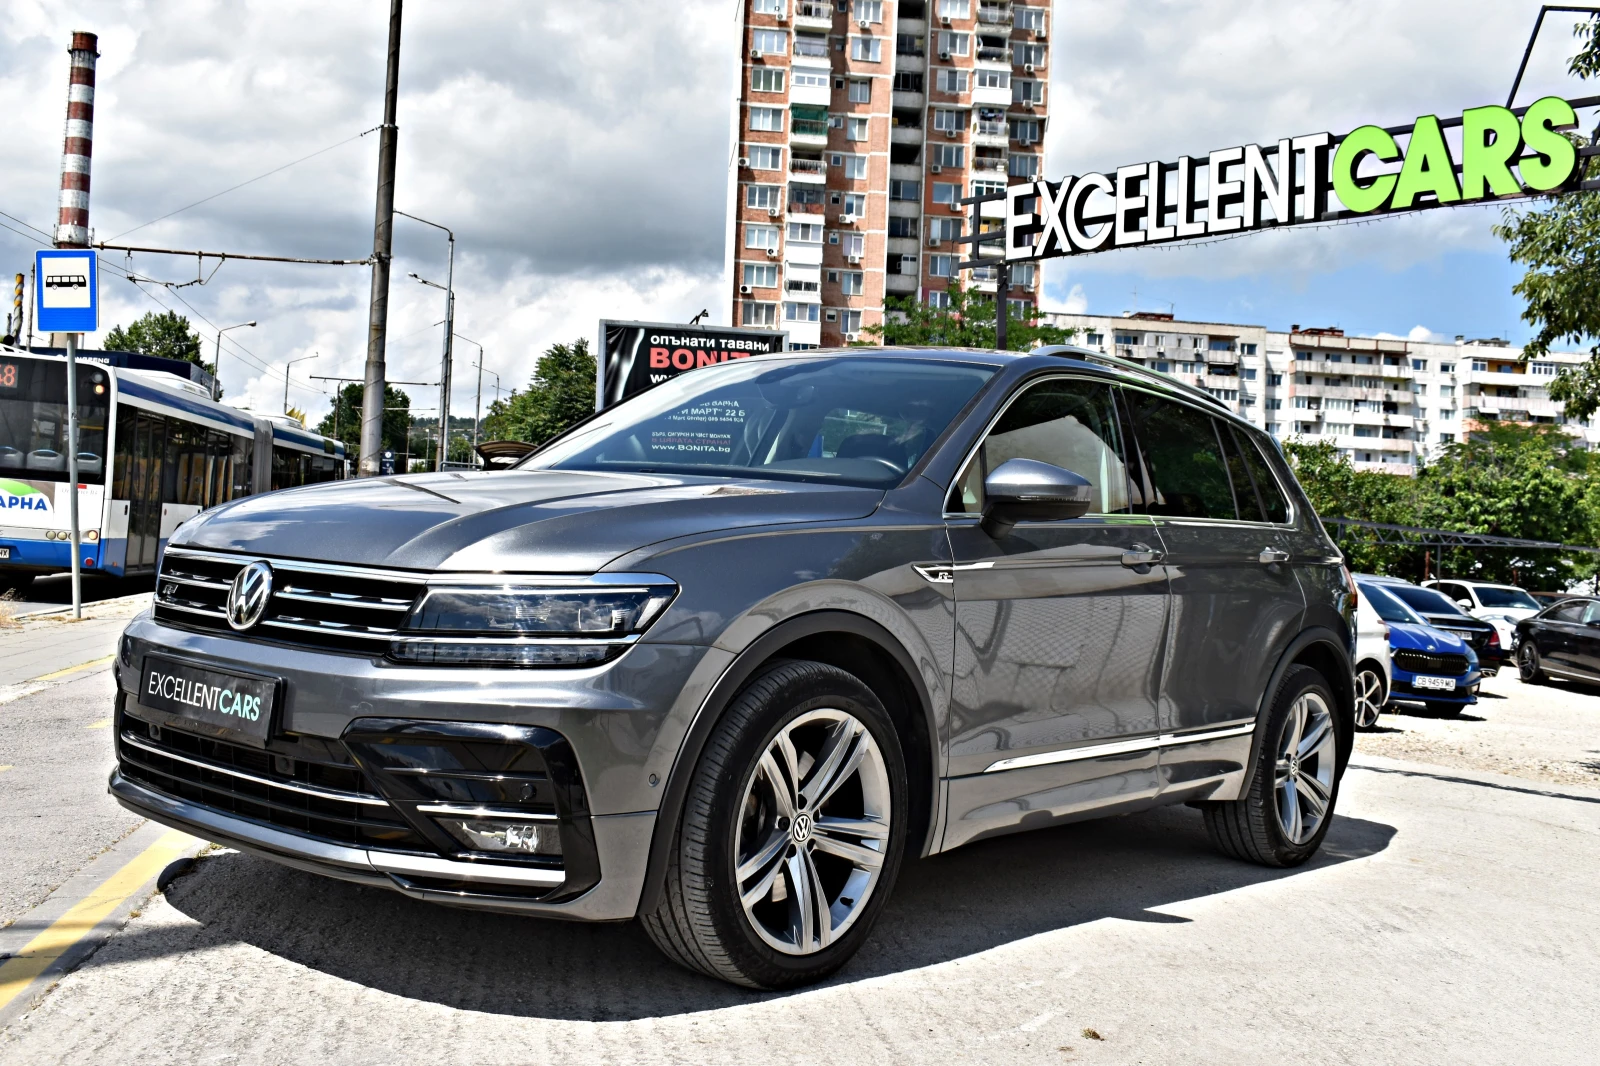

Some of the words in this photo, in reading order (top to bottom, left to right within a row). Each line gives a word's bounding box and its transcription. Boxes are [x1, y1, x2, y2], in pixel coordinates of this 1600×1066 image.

[650, 335, 715, 347] опънати
[719, 339, 770, 352] тавани
[0, 364, 16, 386] 8
[651, 444, 731, 453] www.BONITA.bg
